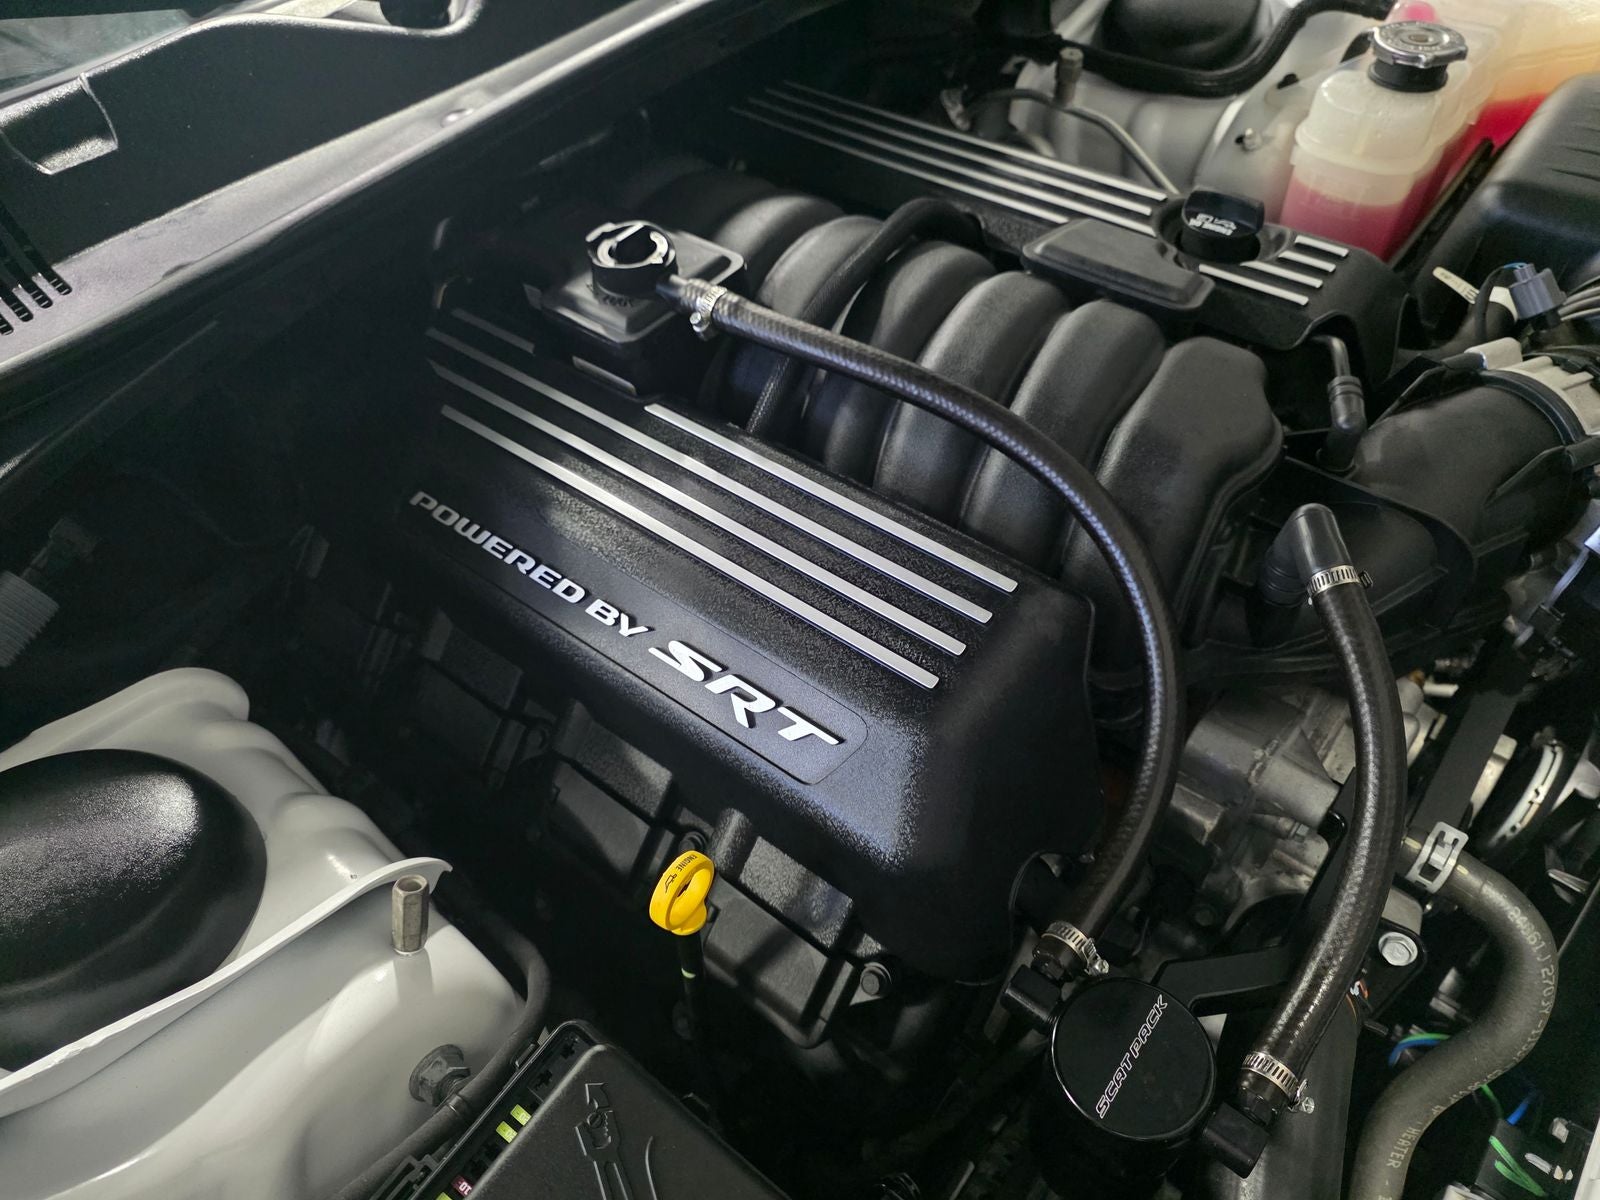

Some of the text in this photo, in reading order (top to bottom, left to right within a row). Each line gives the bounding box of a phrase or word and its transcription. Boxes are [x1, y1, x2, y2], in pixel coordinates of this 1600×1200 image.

[409, 491, 841, 746] POWERED BY SRT
[675, 853, 698, 872] ENGINE
[1095, 993, 1168, 1119] SCAT PACK
[1385, 1126, 1423, 1168] HEATER
